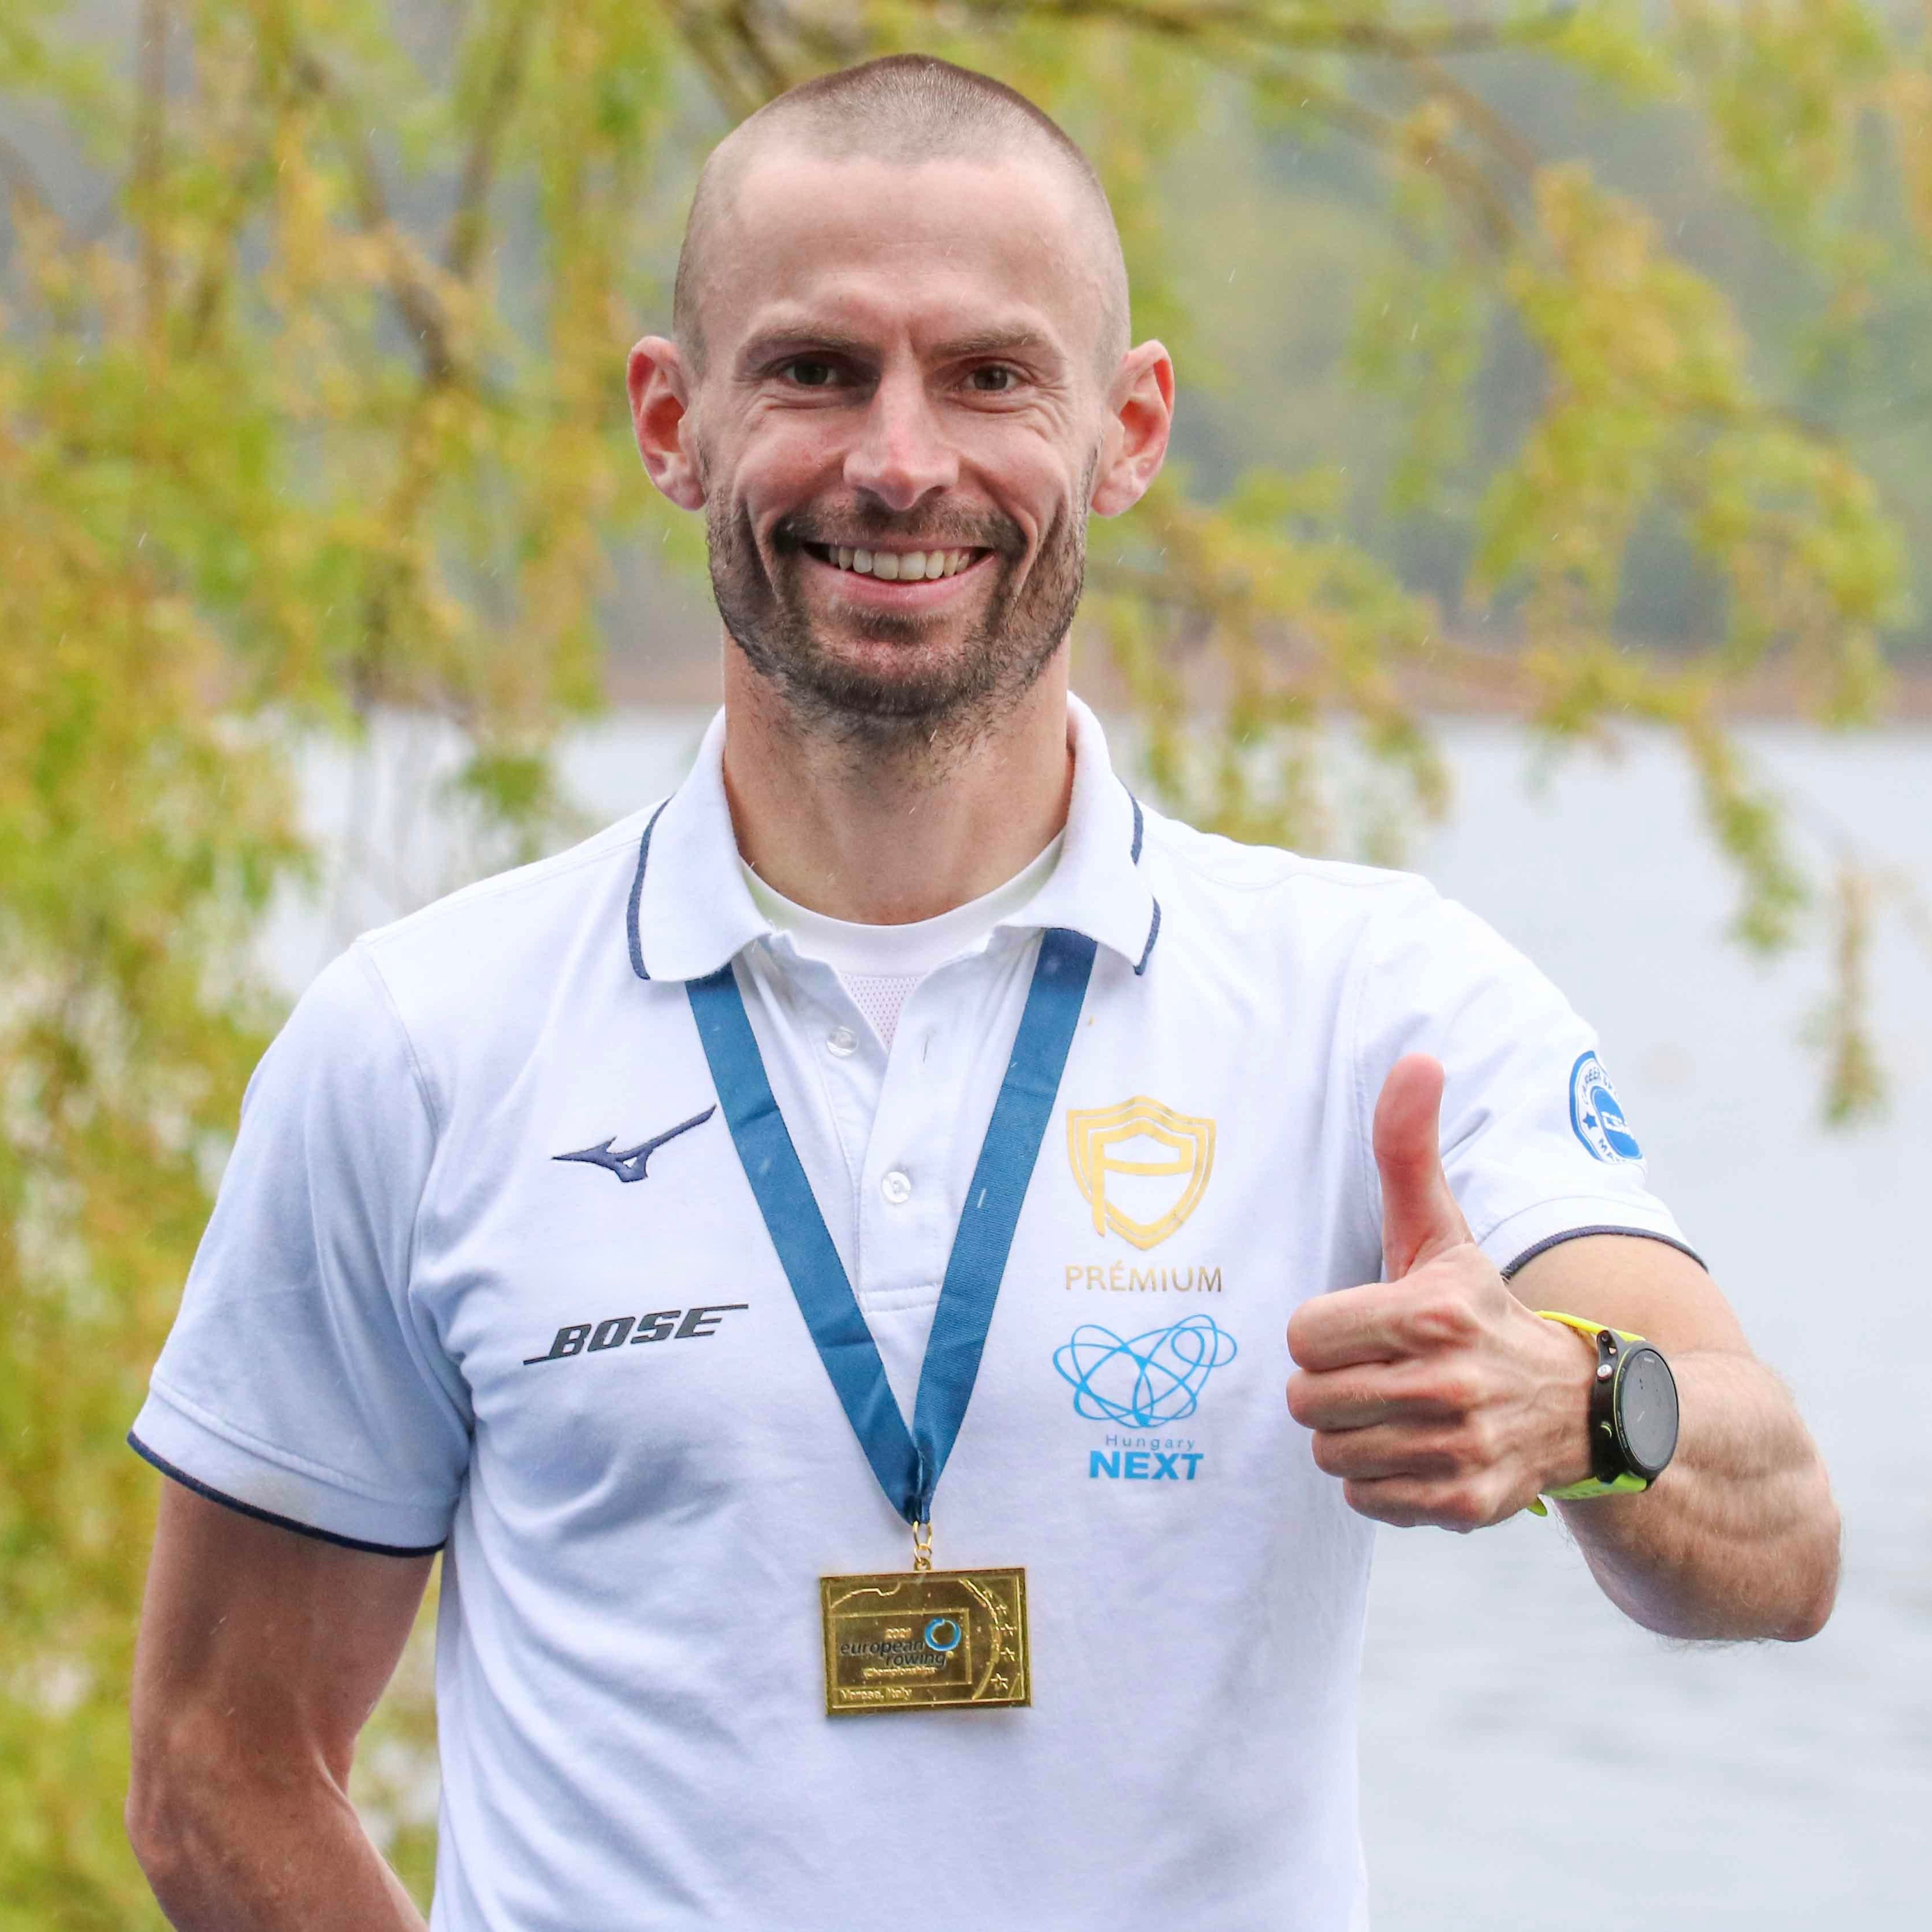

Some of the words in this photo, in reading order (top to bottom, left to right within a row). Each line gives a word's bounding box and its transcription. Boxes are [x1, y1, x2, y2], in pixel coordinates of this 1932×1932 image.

[1066, 1260, 1222, 1293] PRÉMIUM
[523, 1303, 749, 1365] BOSE
[1105, 1434, 1196, 1450] Hungary
[1090, 1450, 1204, 1480] NEXT
[840, 1642, 923, 1656] european
[886, 1653, 946, 1667] rowing
